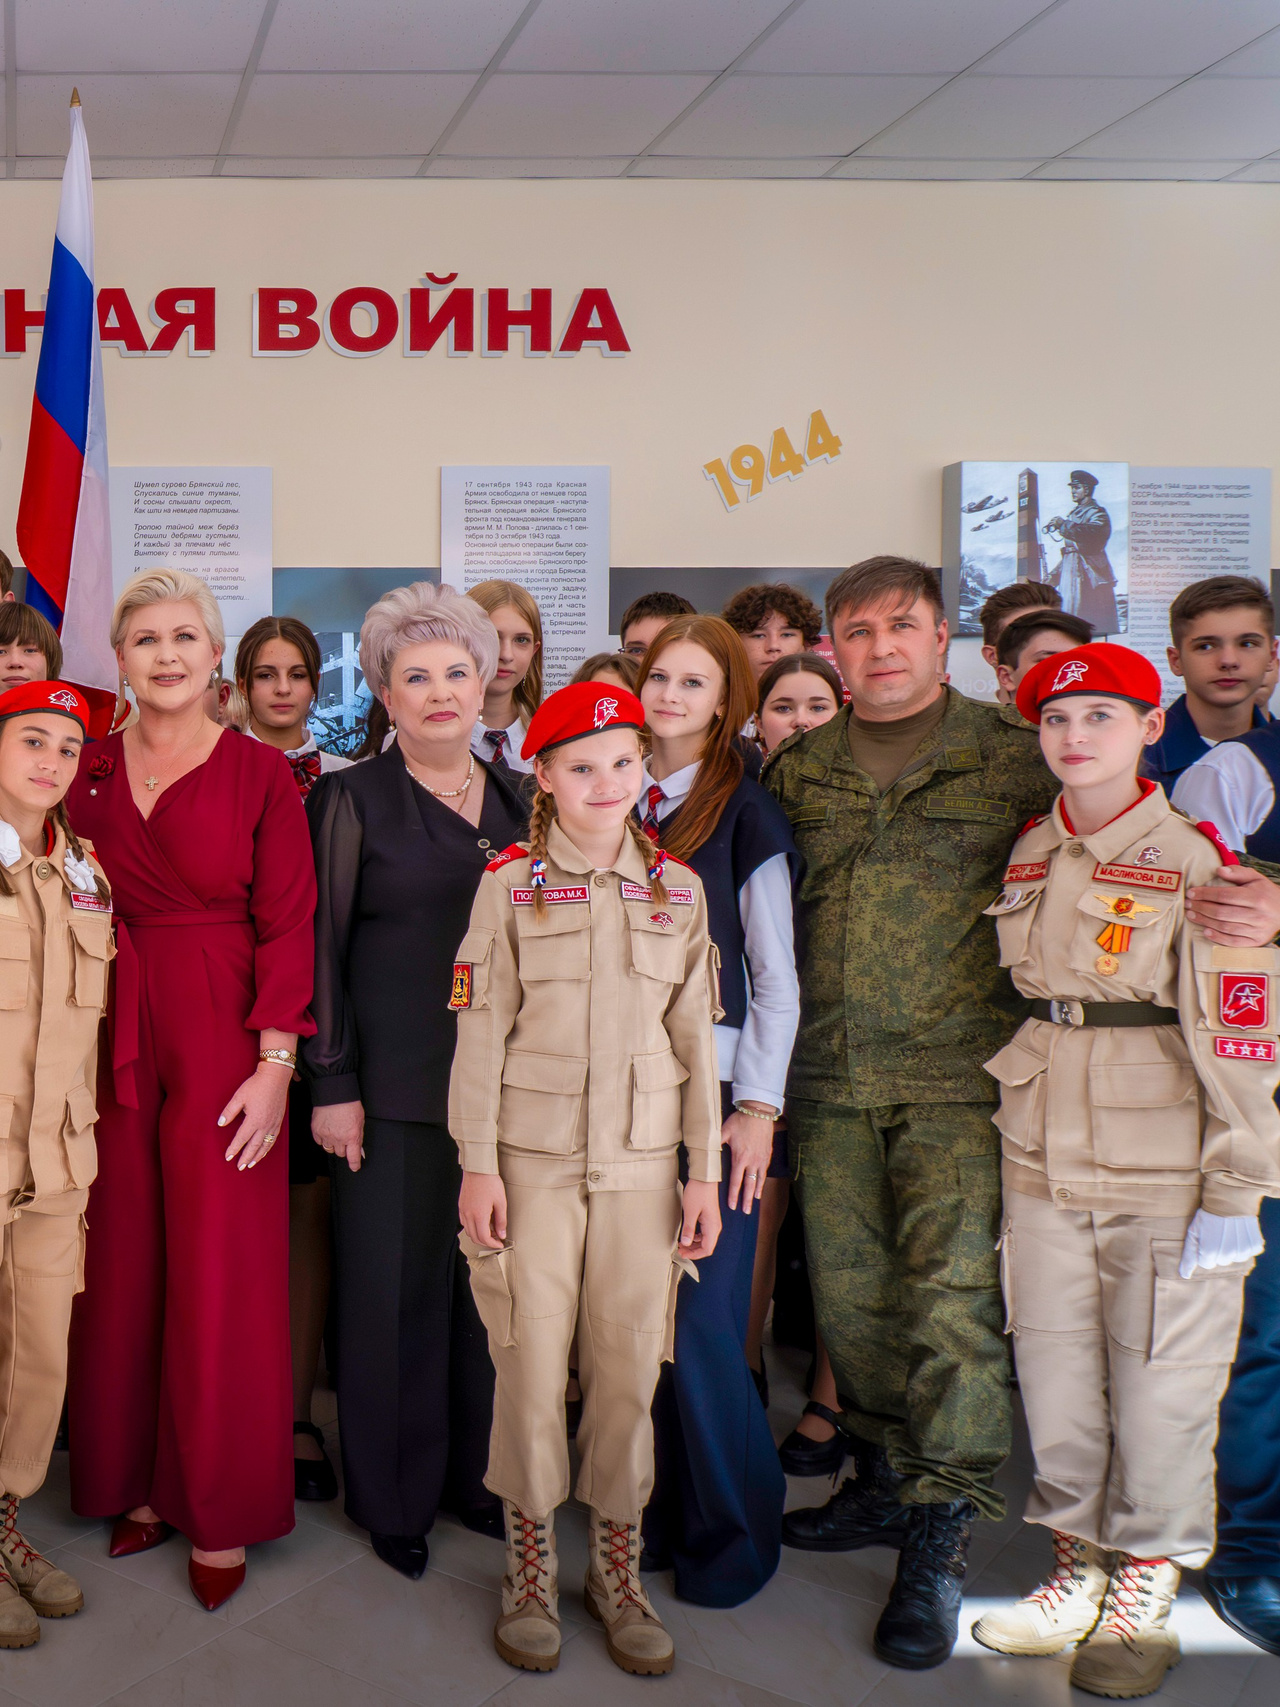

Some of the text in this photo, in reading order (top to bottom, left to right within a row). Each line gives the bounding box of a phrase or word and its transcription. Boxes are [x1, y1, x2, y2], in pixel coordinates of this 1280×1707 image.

[257, 272, 630, 353] ВОЙНА
[703, 409, 842, 507] 1944
[517, 890, 584, 900] ПОЛКОВА М.К.
[1100, 867, 1154, 882] МАСЛИКОВА
